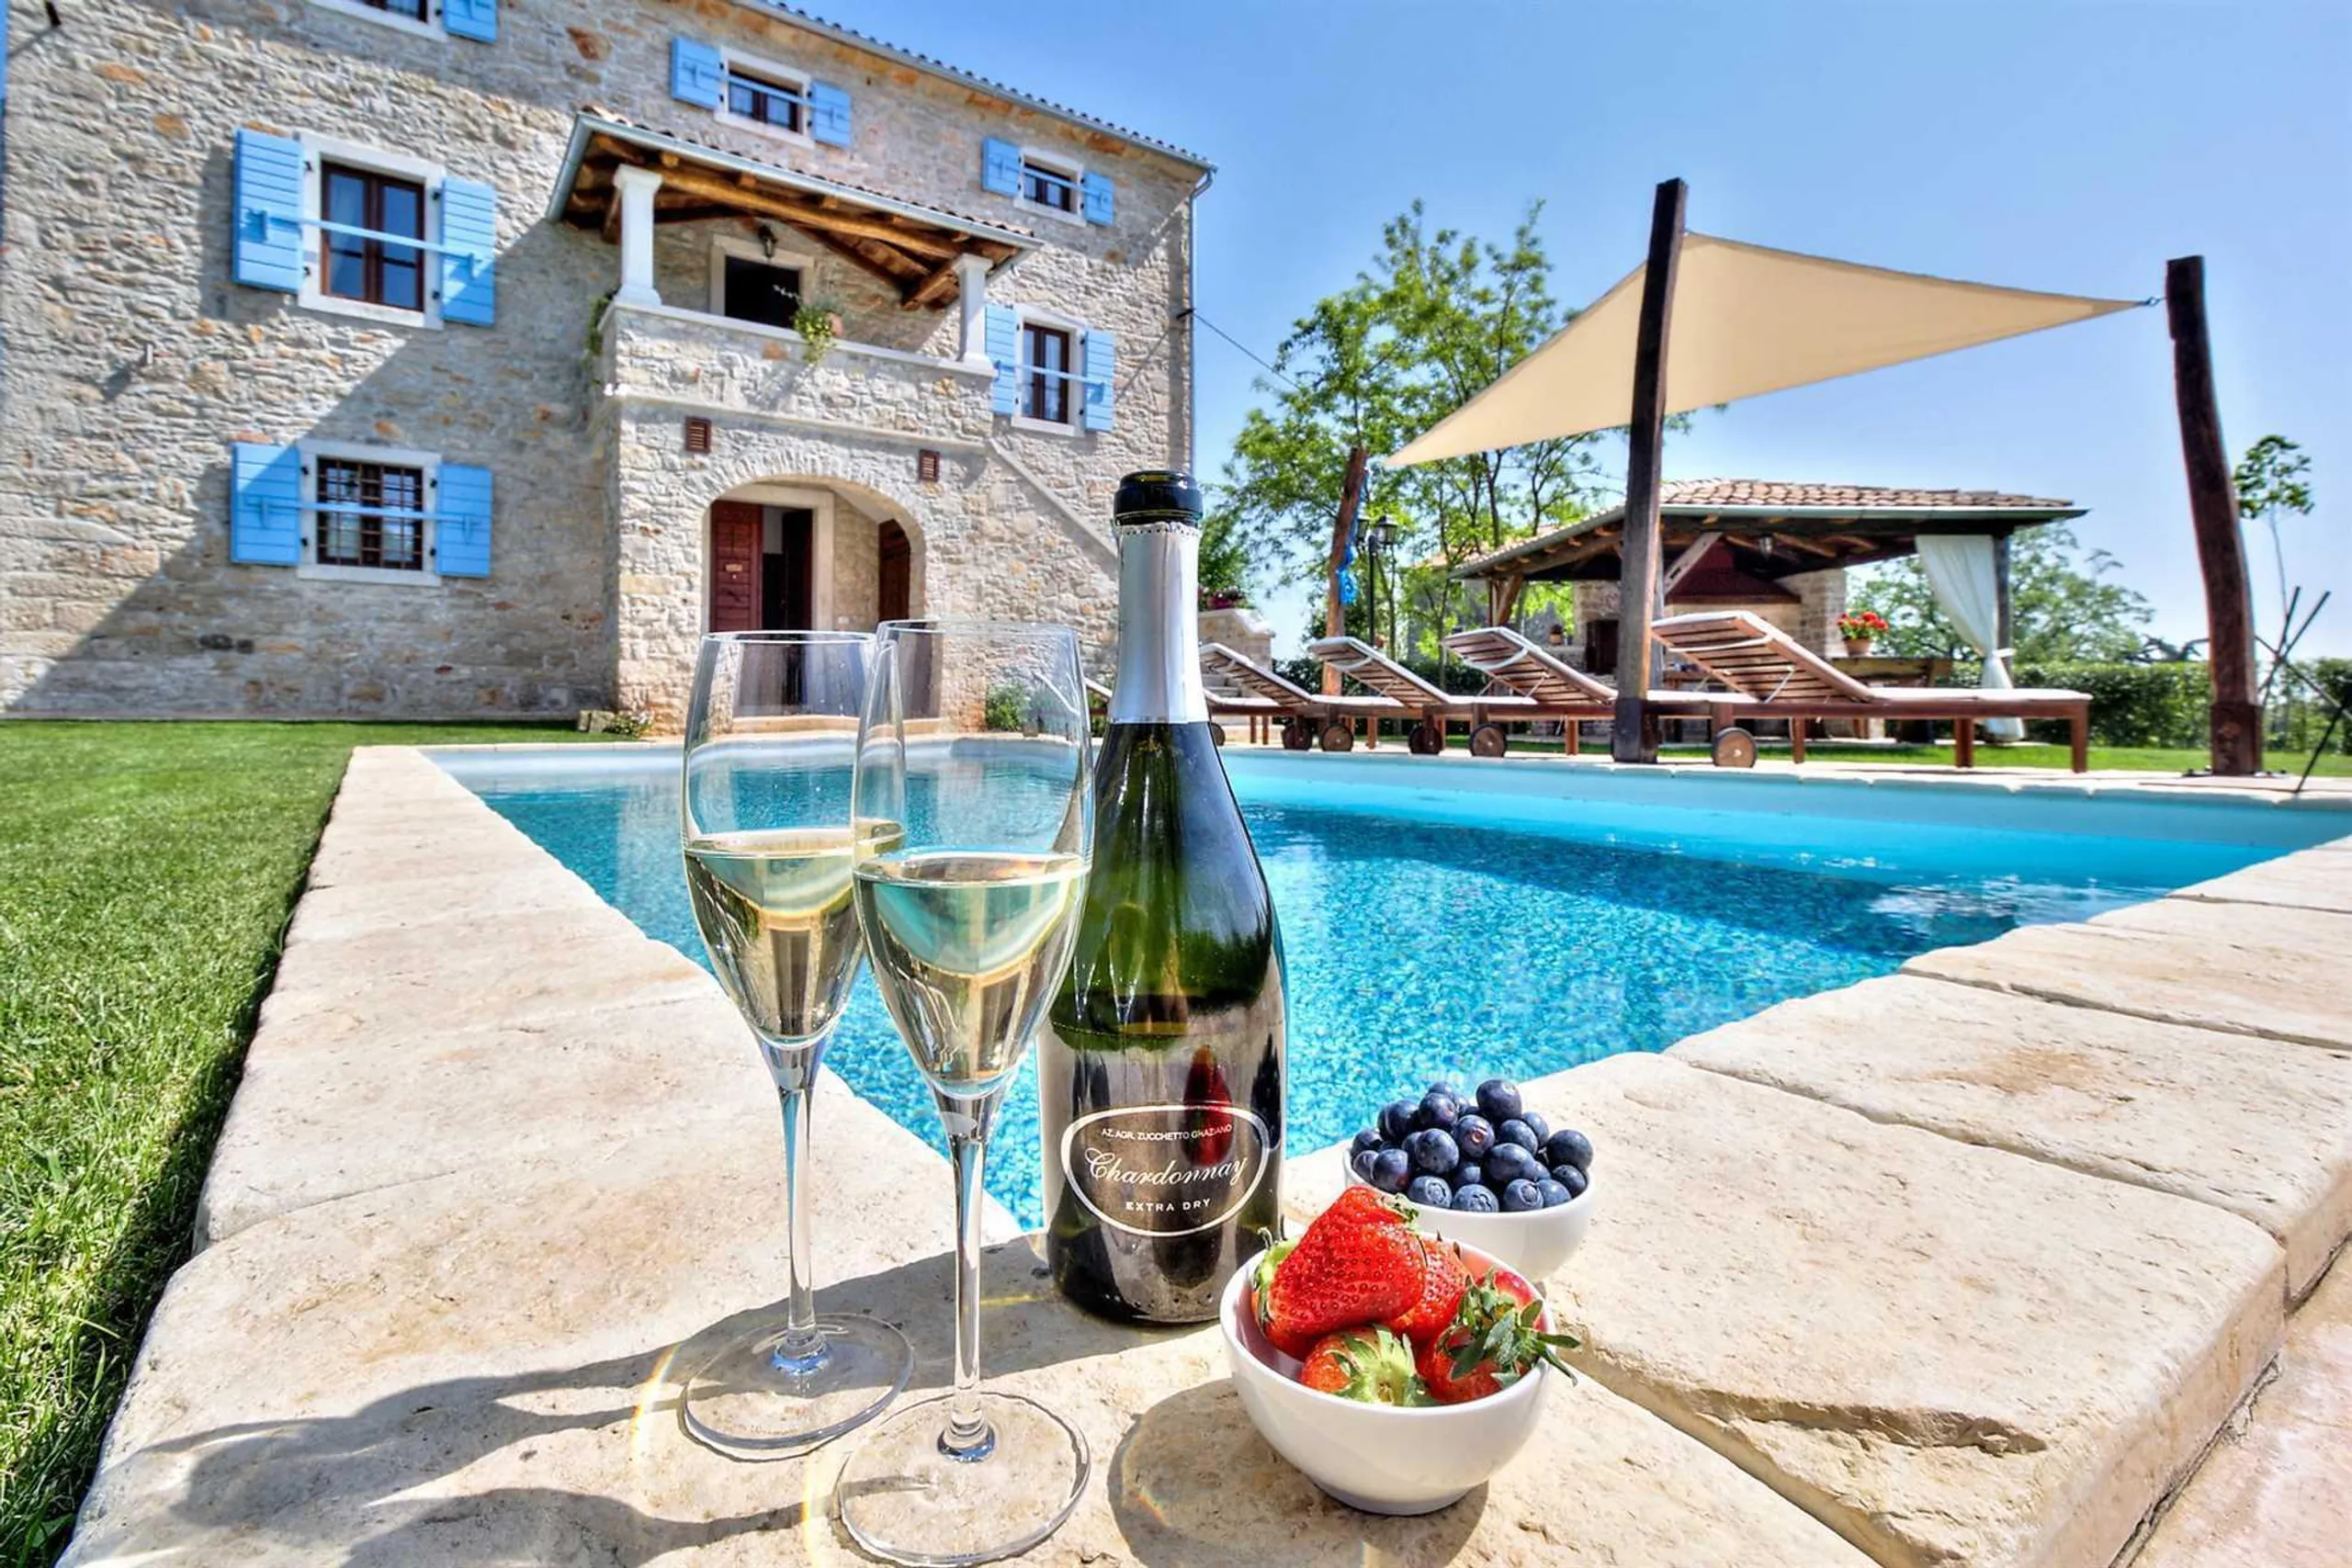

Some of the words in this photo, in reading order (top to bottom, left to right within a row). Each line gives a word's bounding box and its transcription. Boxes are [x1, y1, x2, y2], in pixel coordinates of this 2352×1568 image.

[1136, 1131, 1190, 1141] ZUCCHETTO
[1084, 1147, 1249, 1186] Chardonnay
[1125, 1201, 1175, 1213] EXTRA
[1182, 1197, 1212, 1211] DRY
